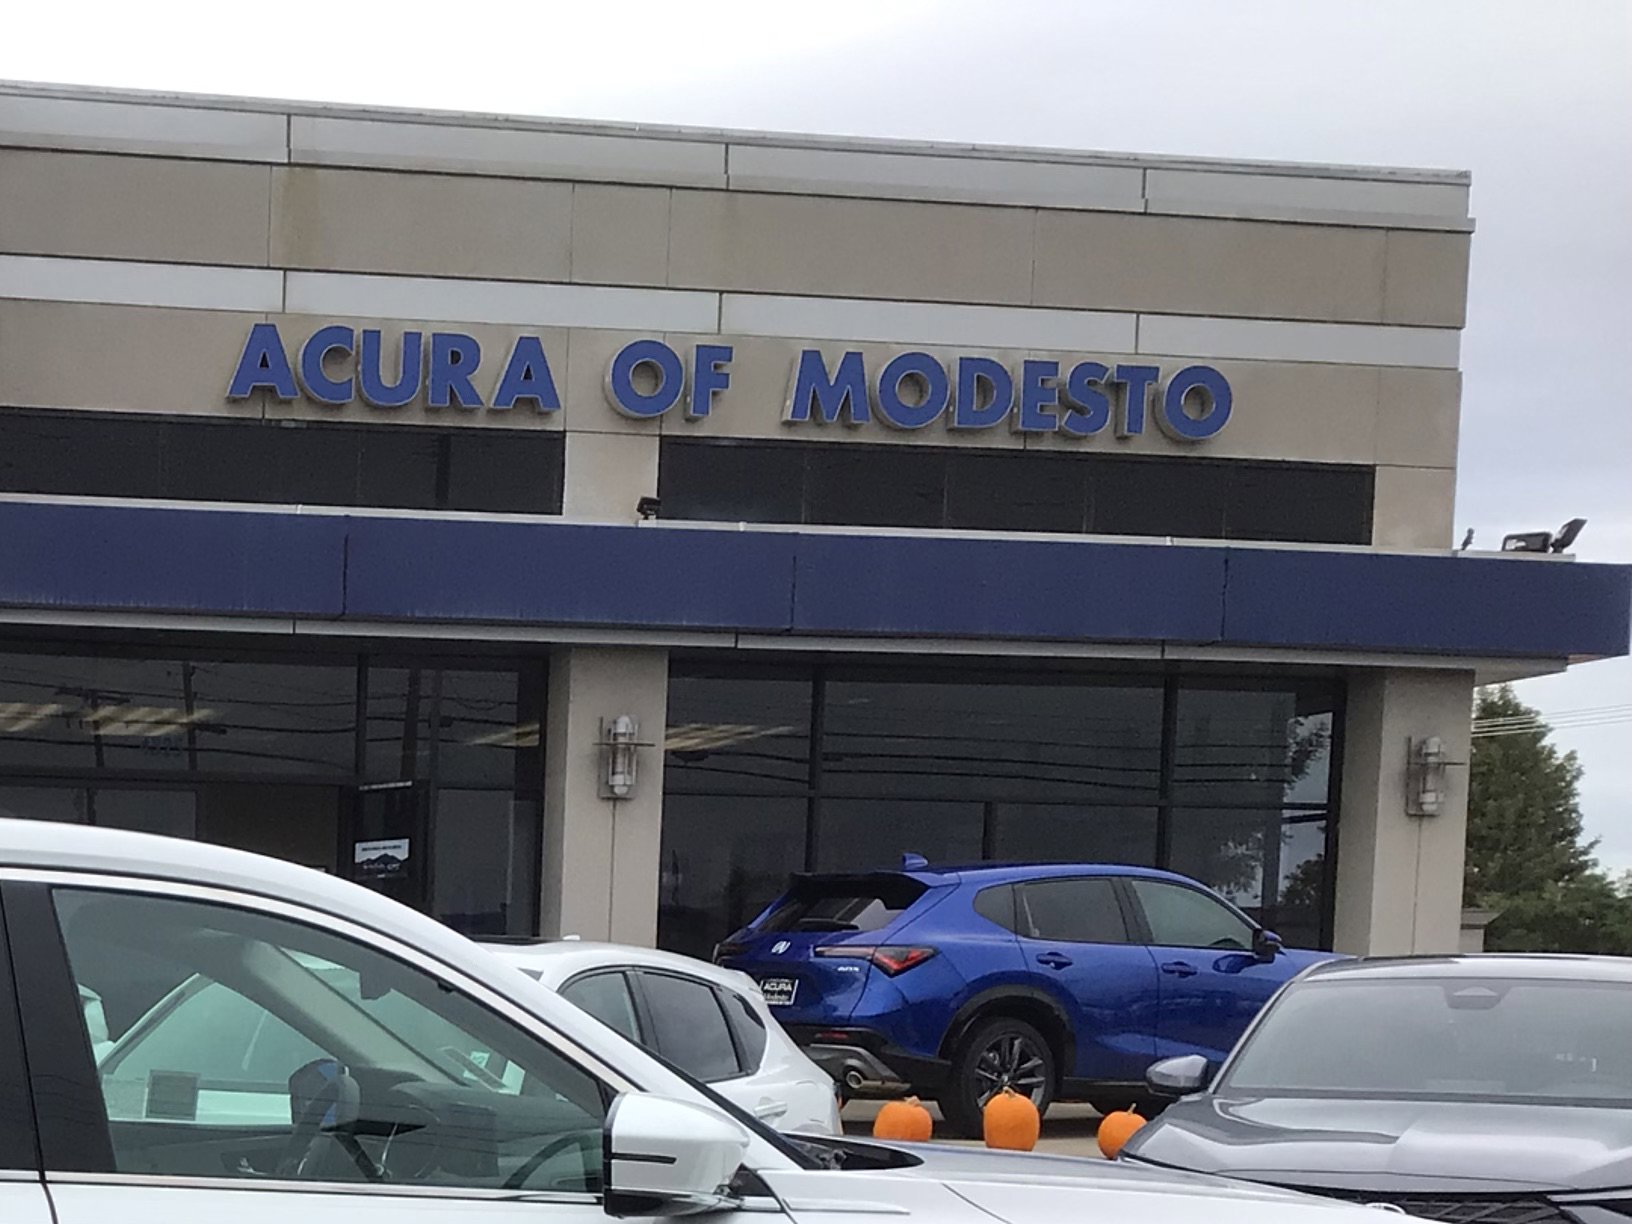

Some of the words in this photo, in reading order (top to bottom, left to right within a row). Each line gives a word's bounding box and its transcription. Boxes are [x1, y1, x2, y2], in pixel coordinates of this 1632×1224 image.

[227, 322, 562, 413] ACURA
[605, 339, 734, 423] OF
[783, 348, 1233, 442] MODESTO
[763, 983, 792, 991] ACURA
